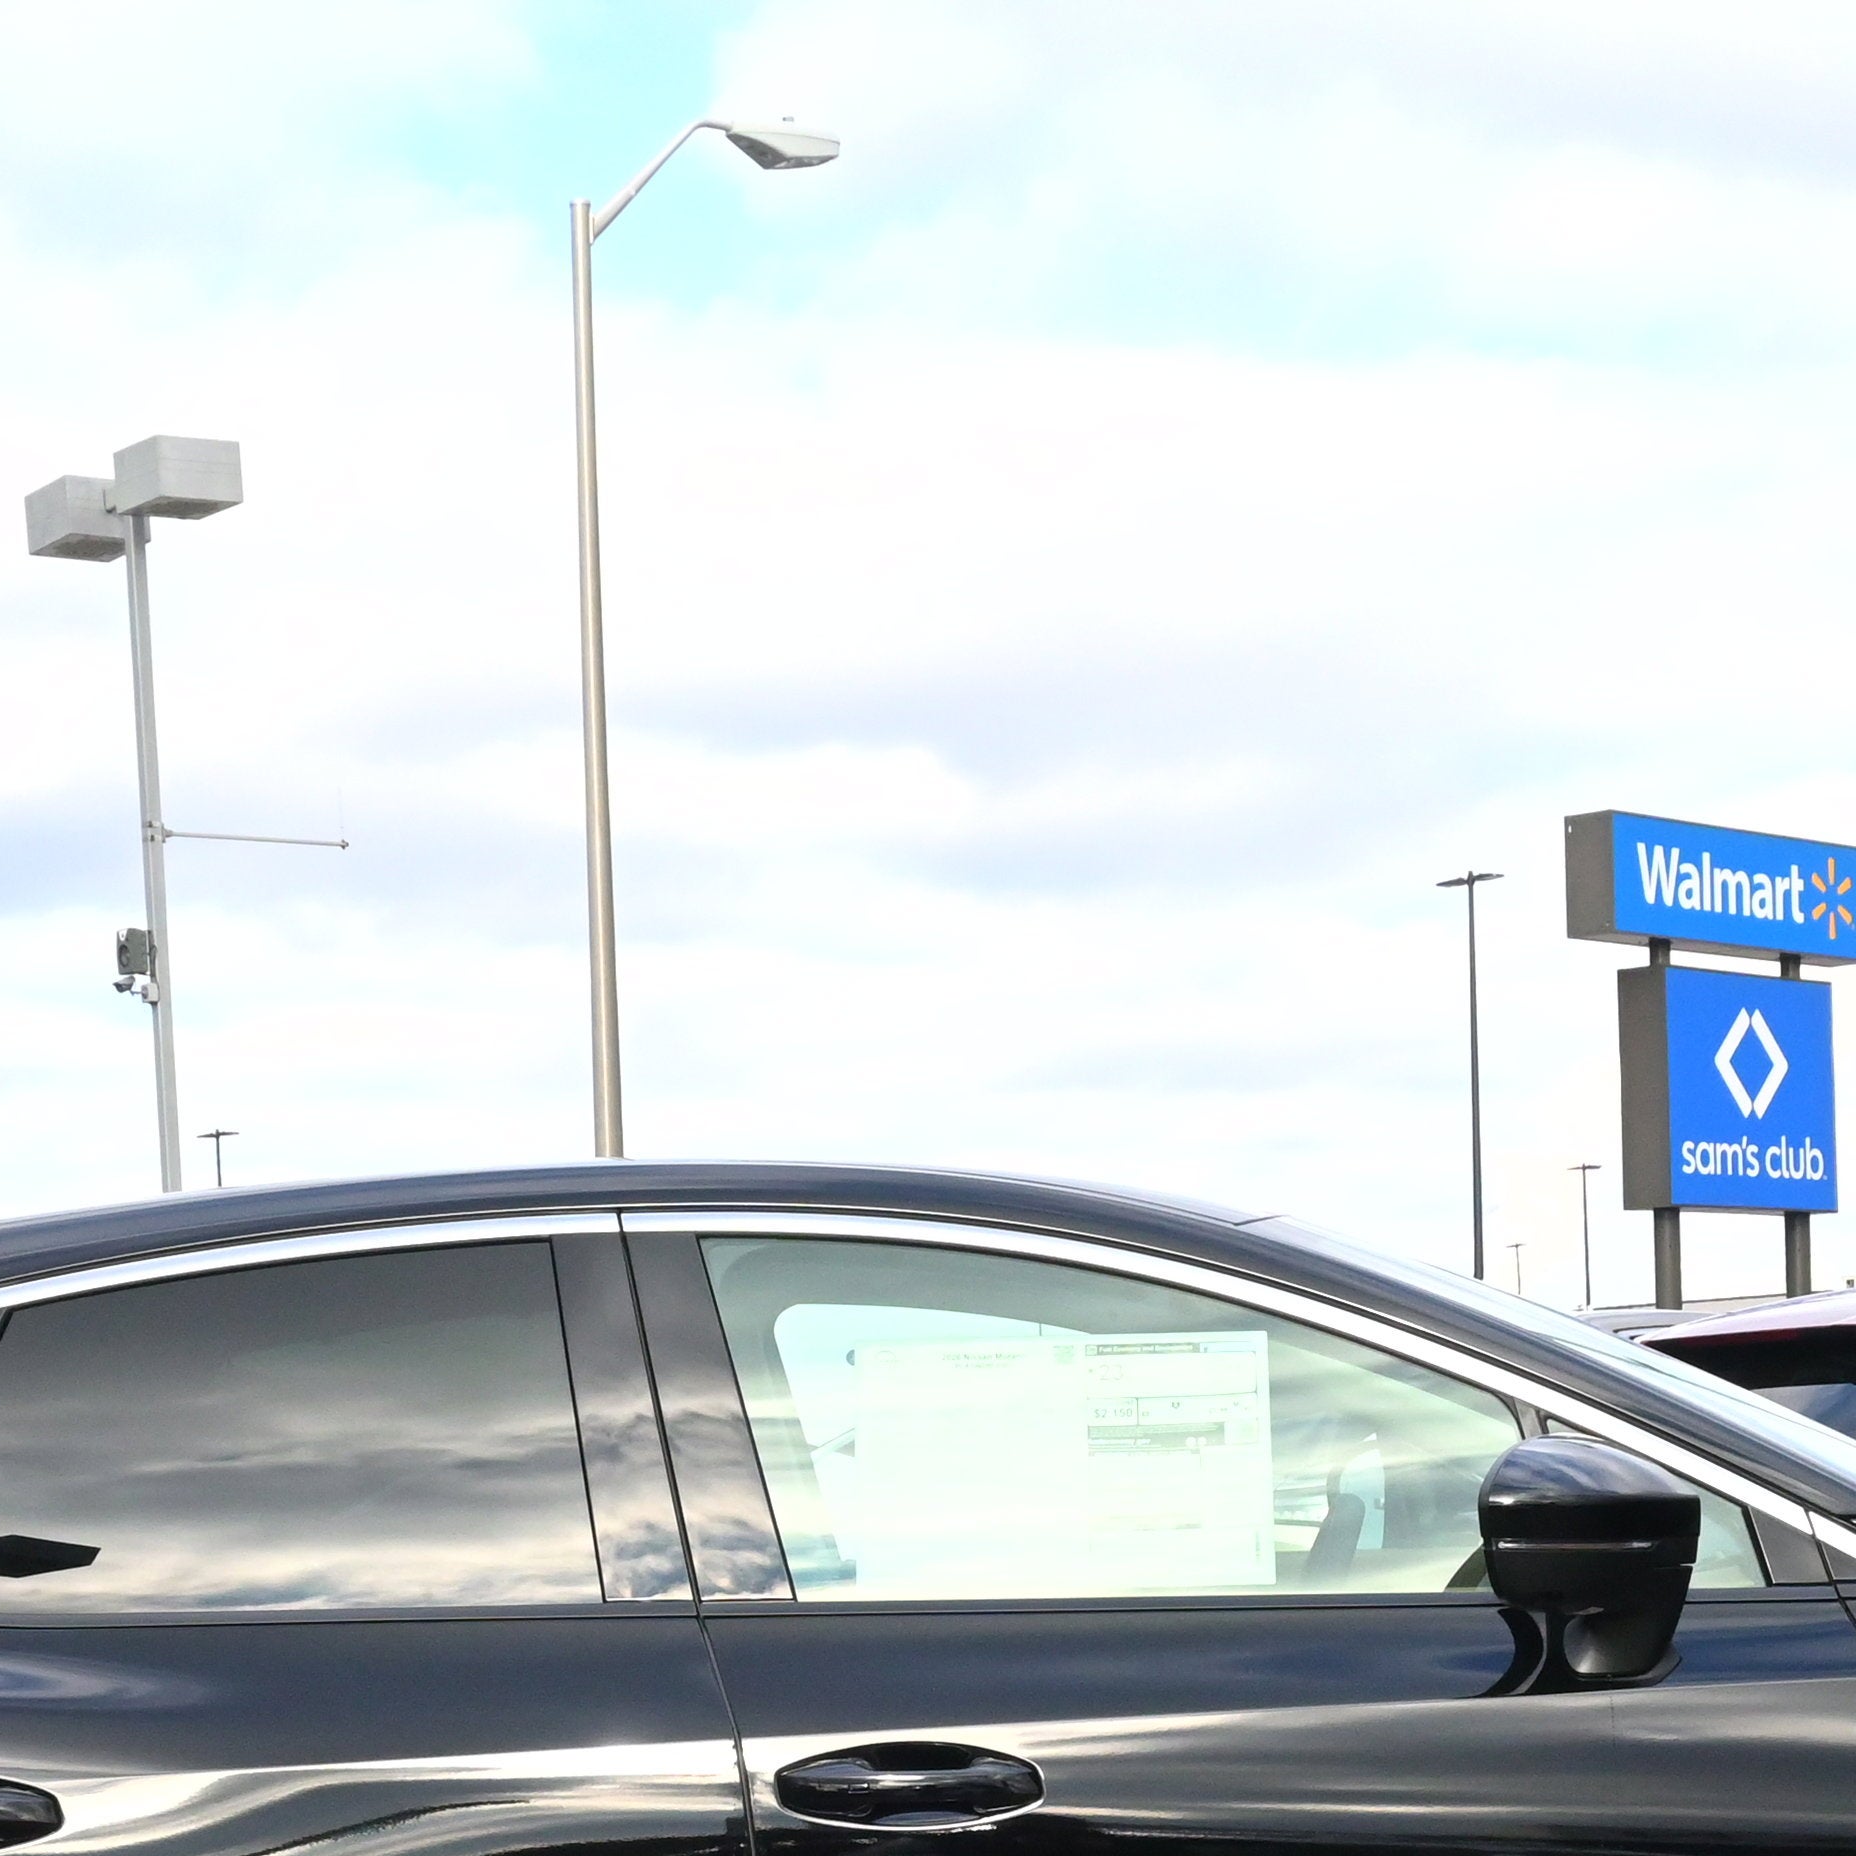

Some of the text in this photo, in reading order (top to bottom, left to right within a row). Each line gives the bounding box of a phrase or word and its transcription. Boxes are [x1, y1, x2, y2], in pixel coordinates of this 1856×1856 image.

[1636, 842, 1805, 924] Walmart
[1682, 1135, 1824, 1180] sam's club
